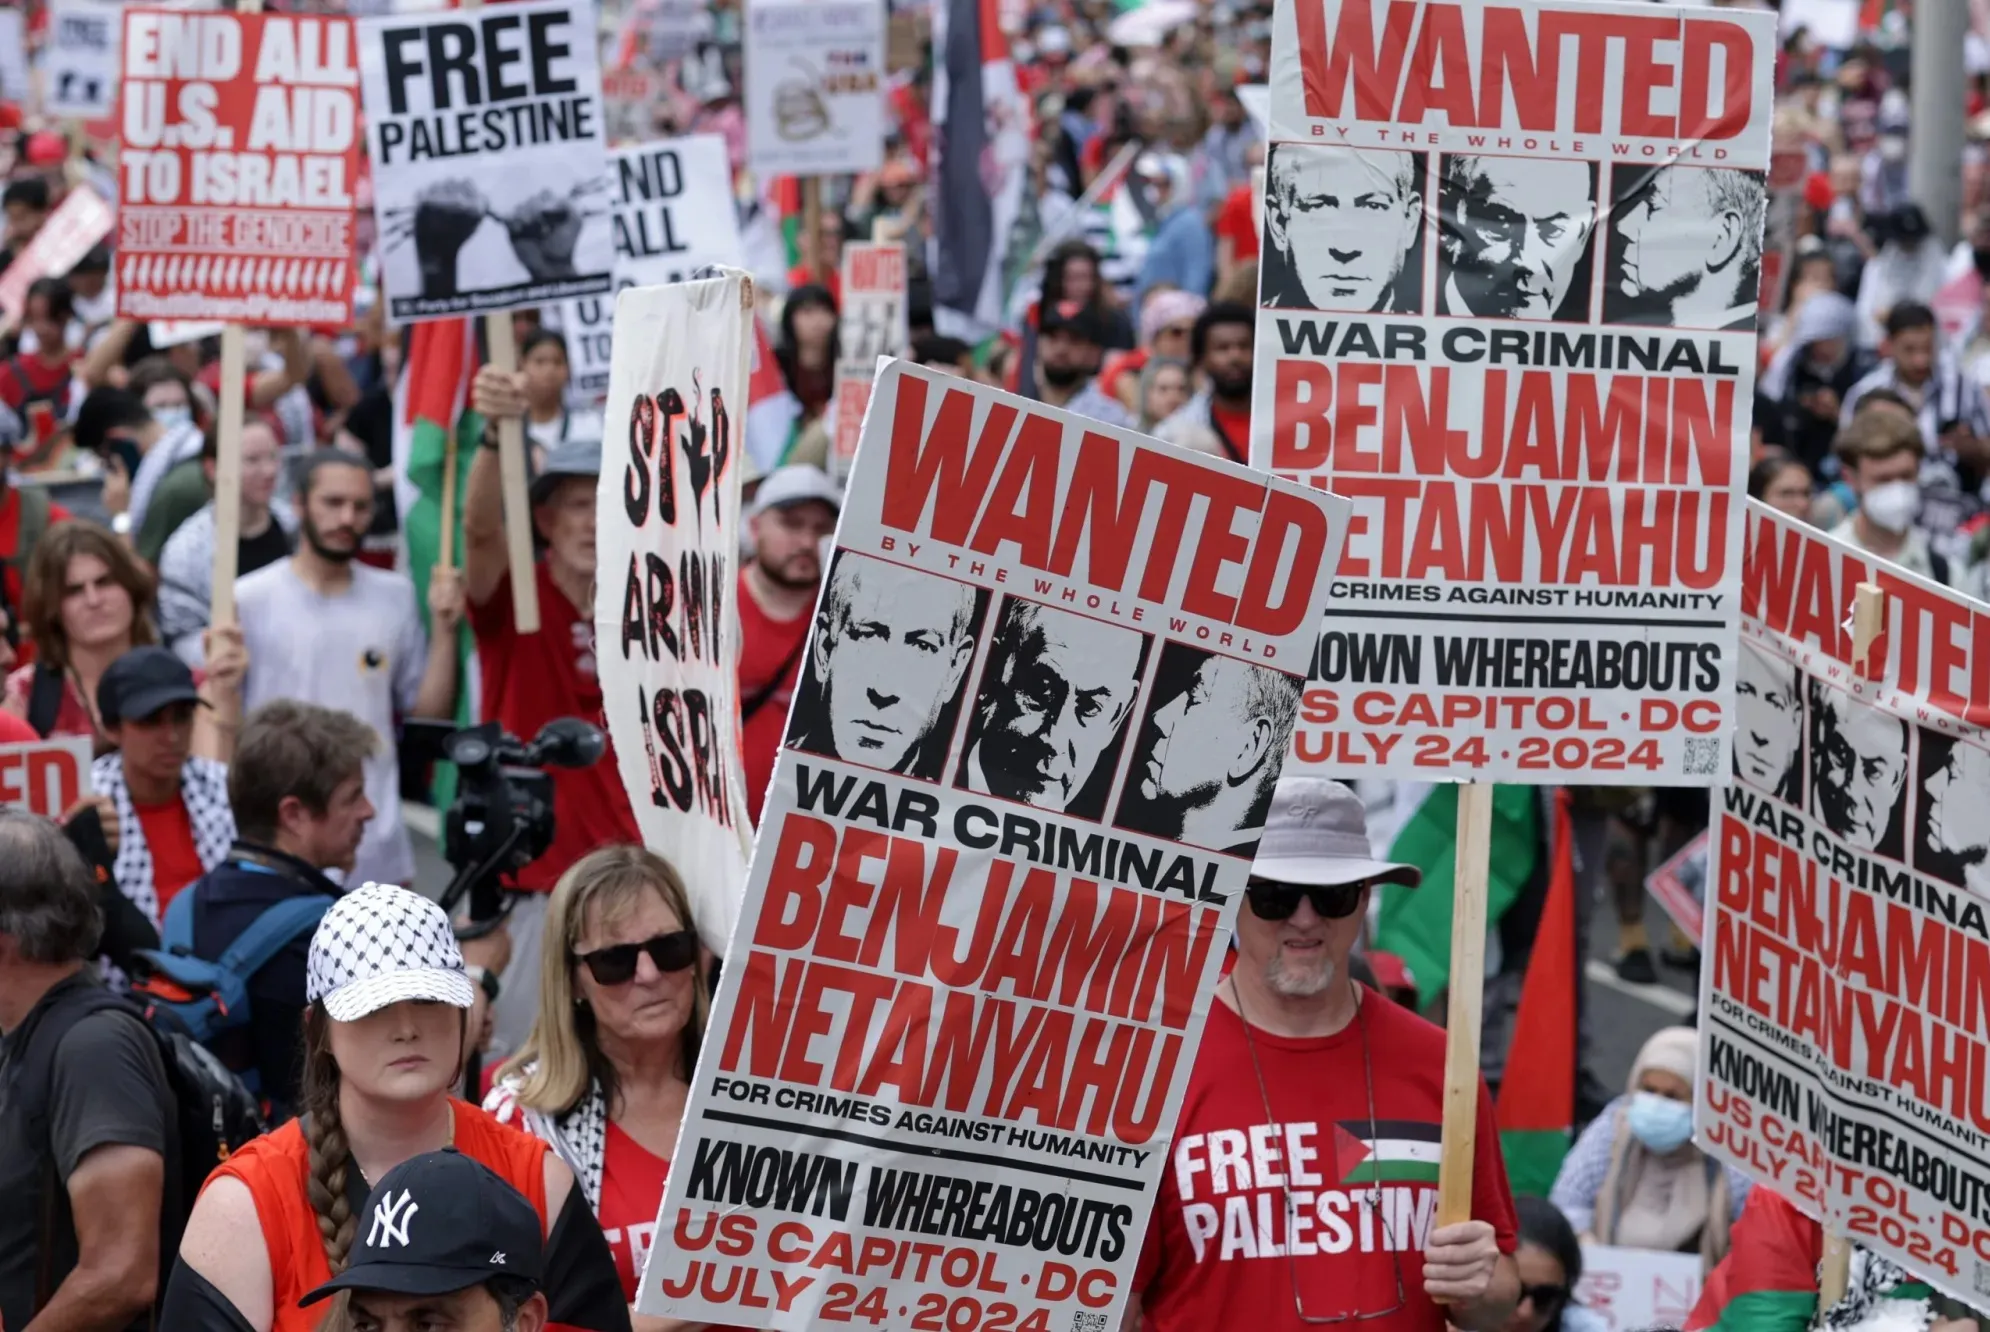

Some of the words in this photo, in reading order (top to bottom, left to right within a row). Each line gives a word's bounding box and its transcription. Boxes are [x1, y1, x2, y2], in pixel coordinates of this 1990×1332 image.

[127, 13, 242, 81] END
[255, 18, 357, 86] ALL
[383, 11, 576, 115] FREE
[1296, 0, 1754, 141] WANTED
[124, 81, 234, 148] U.S.
[249, 85, 355, 152] AID
[379, 98, 595, 163] PALESTINE
[1312, 124, 1349, 138] BY
[1378, 130, 1439, 145] THE
[1468, 135, 1584, 153] WHOLE
[1612, 143, 1728, 160] WORLD
[121, 151, 181, 204] TO
[192, 151, 352, 208] ISRAEL
[606, 150, 684, 203] ND
[122, 213, 181, 245] STOP
[186, 214, 231, 245] THE
[1276, 318, 1426, 361] WAR
[1441, 326, 1739, 375] CRIMINAL
[1271, 359, 1735, 486] BENJAMIN
[881, 372, 1328, 637] WANTED
[1277, 475, 1731, 589] ETANYAHU
[881, 535, 921, 558] BY
[949, 554, 1008, 584] THE
[1035, 578, 1145, 623] WHOLE
[1170, 616, 1277, 659] WORLD
[1329, 581, 1441, 602] CRIMES
[1446, 586, 1569, 606] AGAINST
[1575, 590, 1724, 611] HUMANITY
[1309, 631, 1423, 685] OWN
[1434, 635, 1721, 692] WHEREABOUTS
[1742, 620, 1763, 638] BY
[1775, 640, 1810, 665] THE
[1828, 664, 1898, 708] WOLE
[1288, 730, 1403, 765] ULY
[1413, 734, 1490, 768] 24
[1517, 737, 1664, 773] 2024
[1300, 689, 1339, 725] S
[1354, 691, 1608, 732] CAPITOL
[1639, 699, 1721, 734] DC
[796, 765, 939, 839] WAR
[953, 804, 1228, 907] CRIMINAL
[1724, 787, 1804, 850] WAR
[1812, 832, 1990, 940] CRIMINA
[752, 812, 1220, 1031] BENJAMIN
[719, 951, 1185, 1145] NETANYAHU
[1709, 1033, 1801, 1122] KNOWN
[1711, 993, 1743, 1023] FOR
[1747, 1013, 1813, 1060] CRIMES
[1816, 1052, 1892, 1100] AGAINST
[711, 1077, 771, 1105] FOR
[775, 1087, 891, 1127] CRIMES
[895, 1110, 1006, 1144] AGAINST
[1006, 1126, 1151, 1170] HUMANITY
[1174, 1122, 1322, 1200] FREE
[1706, 1080, 1752, 1130] US
[1760, 1113, 1920, 1224] CAPITOL
[685, 1138, 859, 1222] KNOWN
[863, 1166, 1132, 1263] WHEREABOUTS
[1182, 1187, 1439, 1264] PALESTIN
[1706, 1120, 1789, 1180] JULY
[1847, 1204, 1960, 1276] 2024
[662, 1261, 816, 1313] JULY
[819, 1283, 888, 1325] 24
[910, 1293, 1051, 1332] 2024
[673, 1207, 757, 1257] US
[767, 1221, 1008, 1294] CAPITOL
[1035, 1260, 1117, 1308] DC
